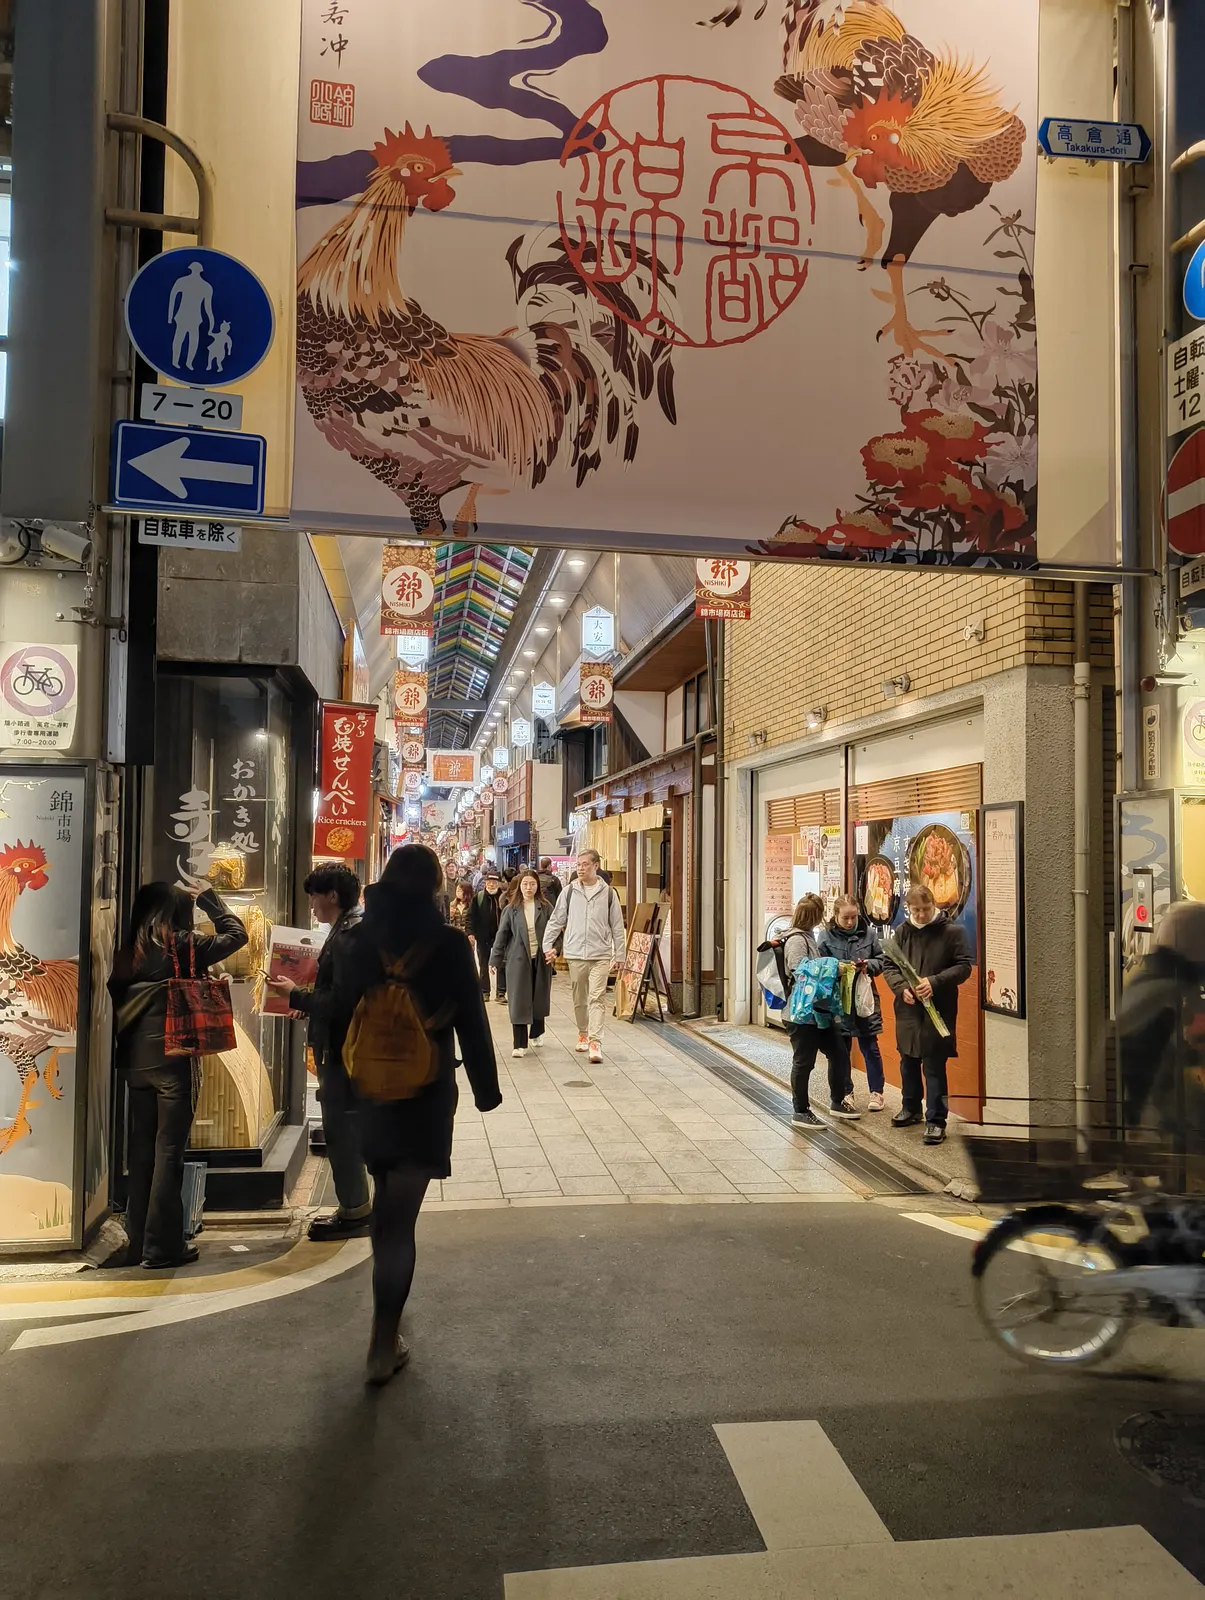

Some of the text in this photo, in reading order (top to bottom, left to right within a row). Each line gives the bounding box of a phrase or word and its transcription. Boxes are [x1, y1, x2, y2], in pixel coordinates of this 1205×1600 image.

[1057, 124, 1132, 146] 高倉通
[1064, 142, 1127, 155] Takakura-dori
[1178, 392, 1201, 421] 12
[143, 517, 236, 544] 自転車を除く
[390, 571, 423, 610] 錦
[704, 579, 727, 587] NISHIKI
[400, 687, 420, 711] 錦
[585, 679, 605, 704] 錦
[49, 790, 74, 843] 錦市場
[231, 758, 260, 853] おかき処
[318, 815, 367, 827] Rice crackers
